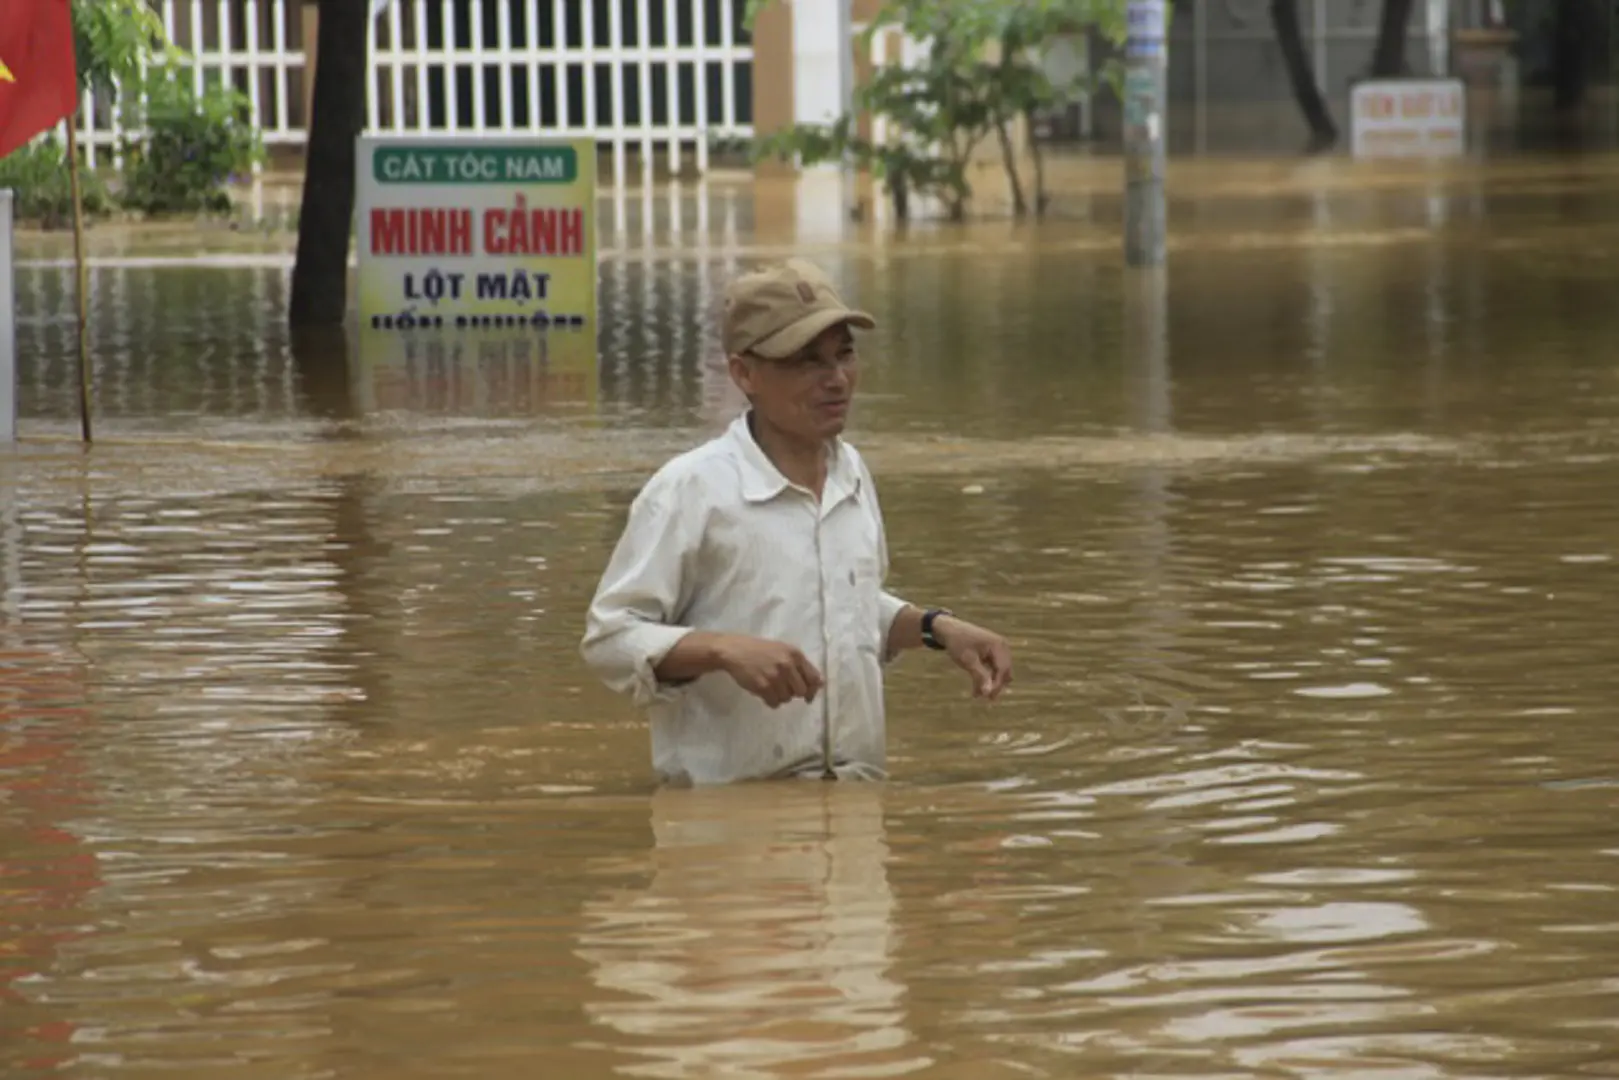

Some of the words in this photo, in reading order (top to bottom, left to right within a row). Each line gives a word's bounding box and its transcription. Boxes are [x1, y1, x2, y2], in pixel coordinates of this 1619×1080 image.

[506, 156, 564, 177] NAM
[370, 209, 471, 256] MINH
[484, 192, 583, 256] CẢNH
[403, 268, 465, 304] LỘT
